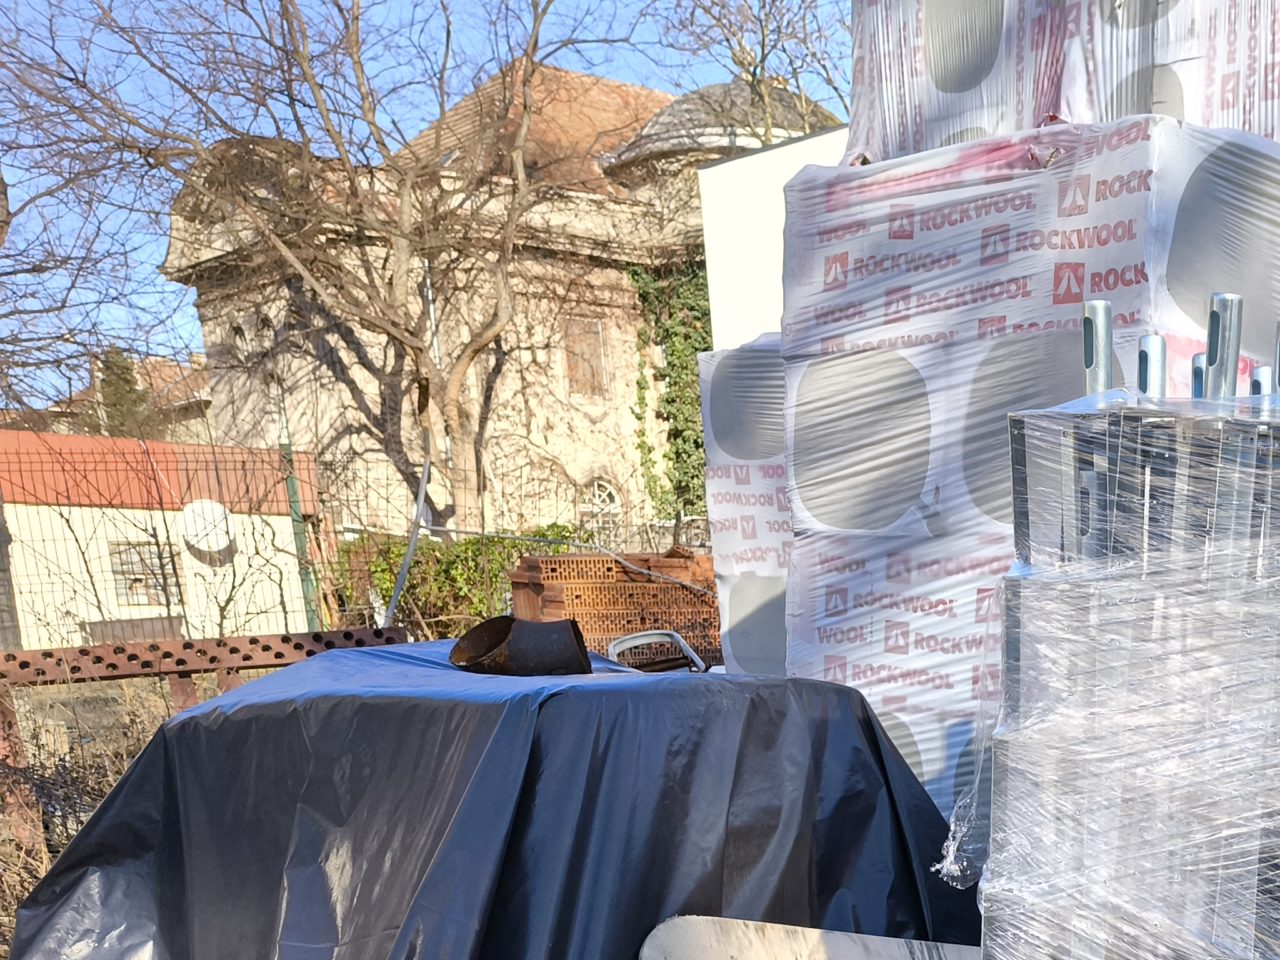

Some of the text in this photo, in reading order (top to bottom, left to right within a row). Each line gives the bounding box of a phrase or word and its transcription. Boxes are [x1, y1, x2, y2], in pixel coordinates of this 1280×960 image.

[1095, 170, 1153, 202] ROCK
[919, 192, 1037, 232] ROCKWOOL
[1015, 219, 1138, 252] ROCKWOOL
[853, 250, 962, 278] ROCKWOOL
[1090, 261, 1149, 293] ROCK
[853, 592, 958, 618] ROCKWOOL
[817, 624, 867, 644] WOOL
[852, 663, 954, 690] ROCKWOOL
